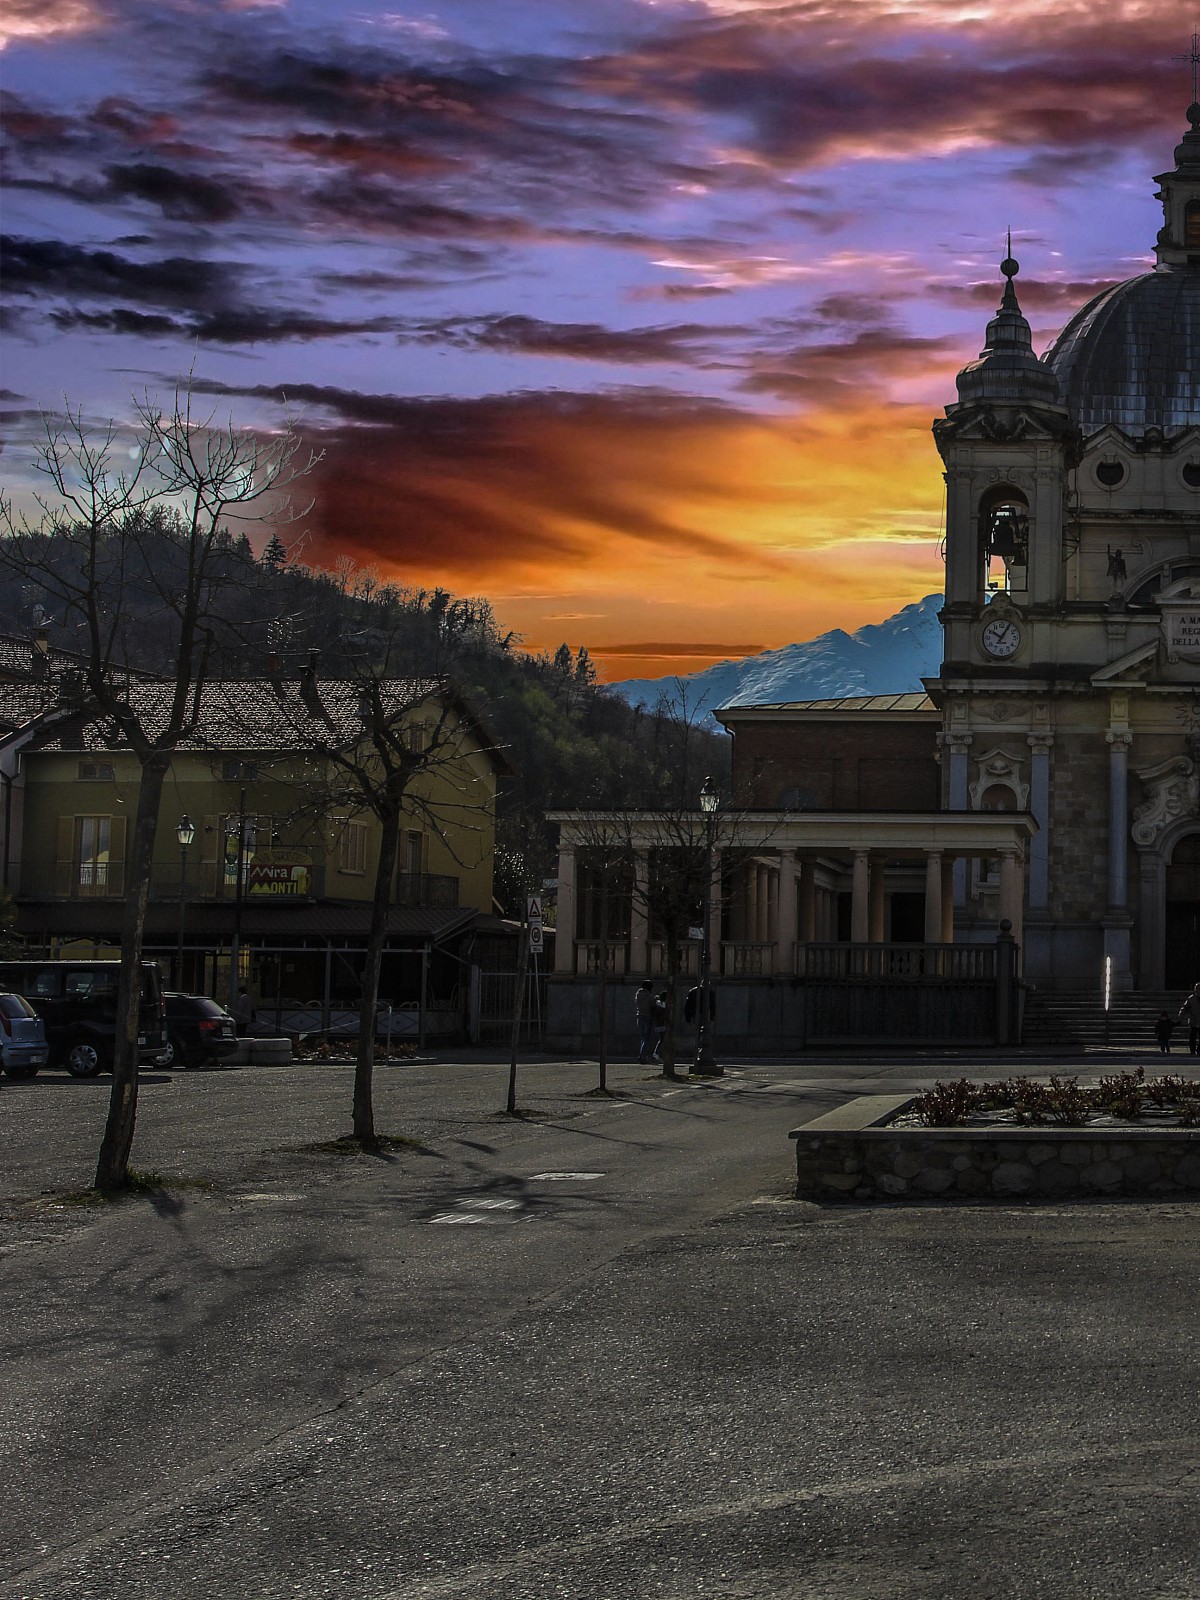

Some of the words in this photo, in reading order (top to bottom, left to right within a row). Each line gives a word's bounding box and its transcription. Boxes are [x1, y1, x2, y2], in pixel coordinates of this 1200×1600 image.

[1172, 638, 1200, 646] DELLA
[250, 865, 288, 878] Mira
[249, 881, 297, 895] MONTI
